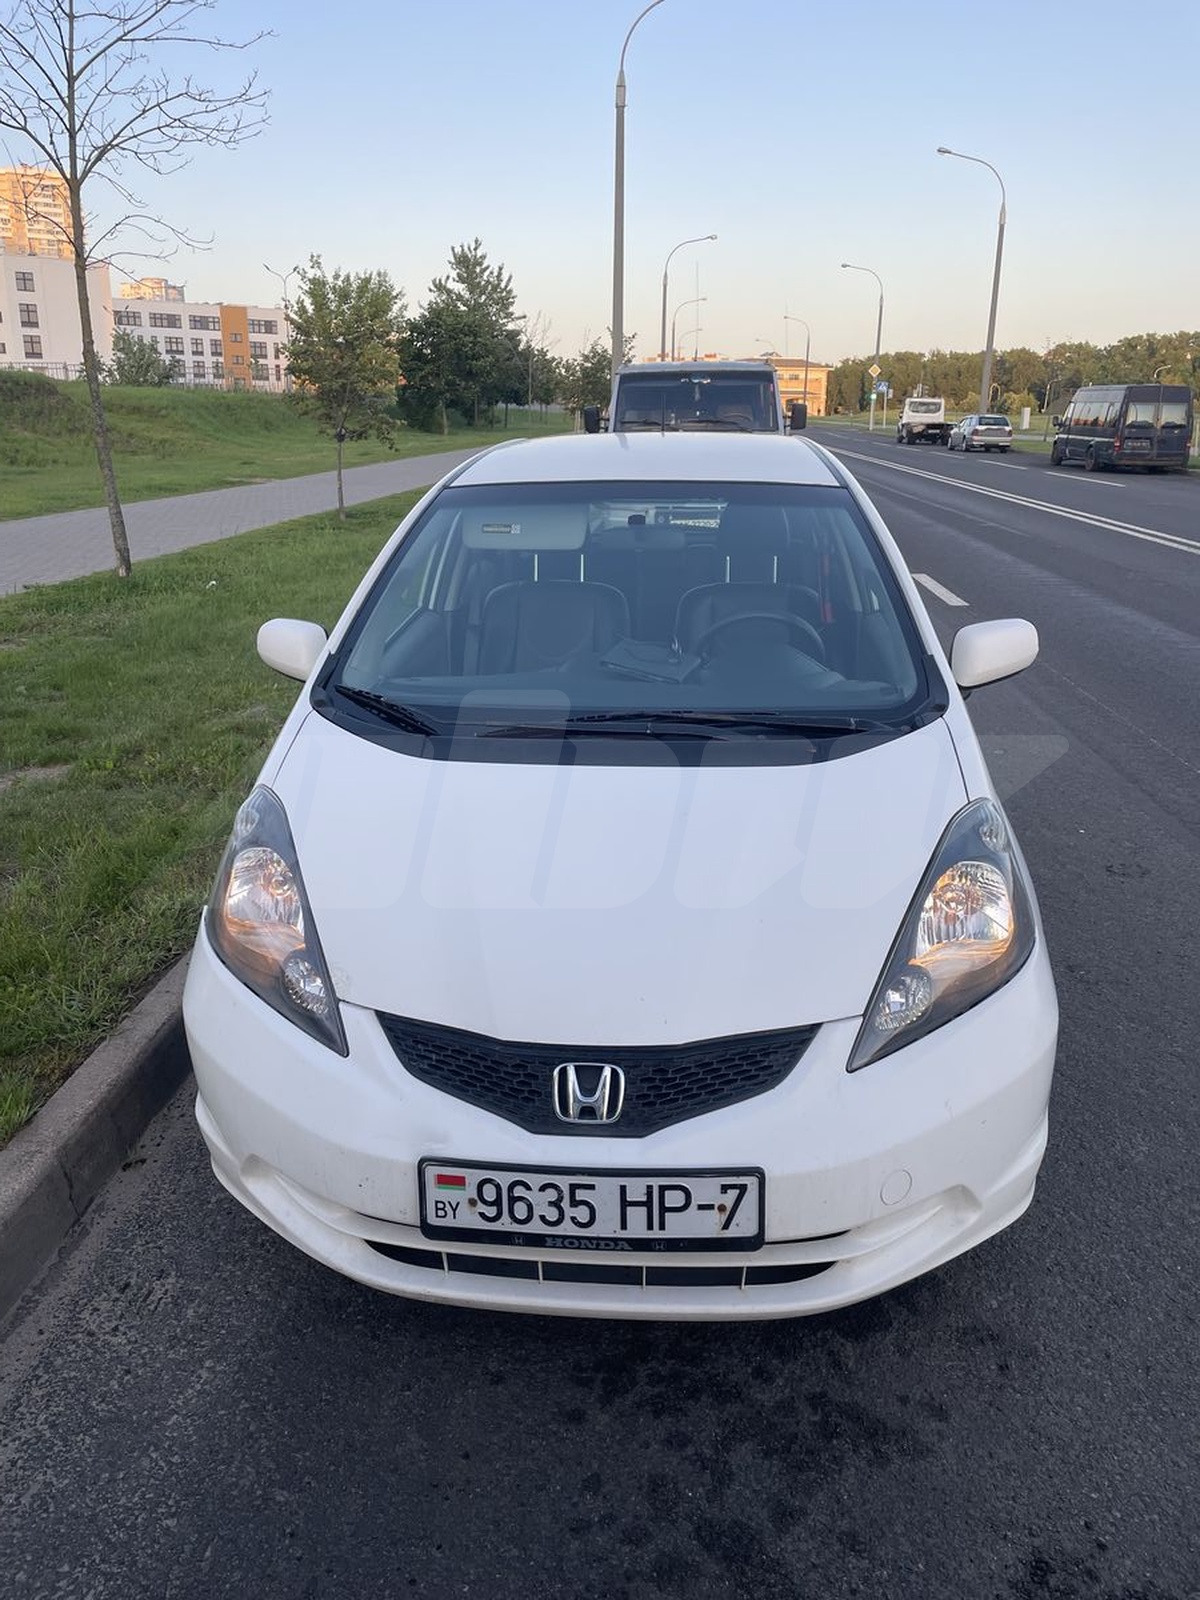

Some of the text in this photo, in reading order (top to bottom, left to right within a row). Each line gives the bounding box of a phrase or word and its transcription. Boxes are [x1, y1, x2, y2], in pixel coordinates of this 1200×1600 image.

[434, 1200, 461, 1220] BY
[475, 1177, 749, 1232] 9635 HP-7
[544, 1236, 634, 1250] HONDA
